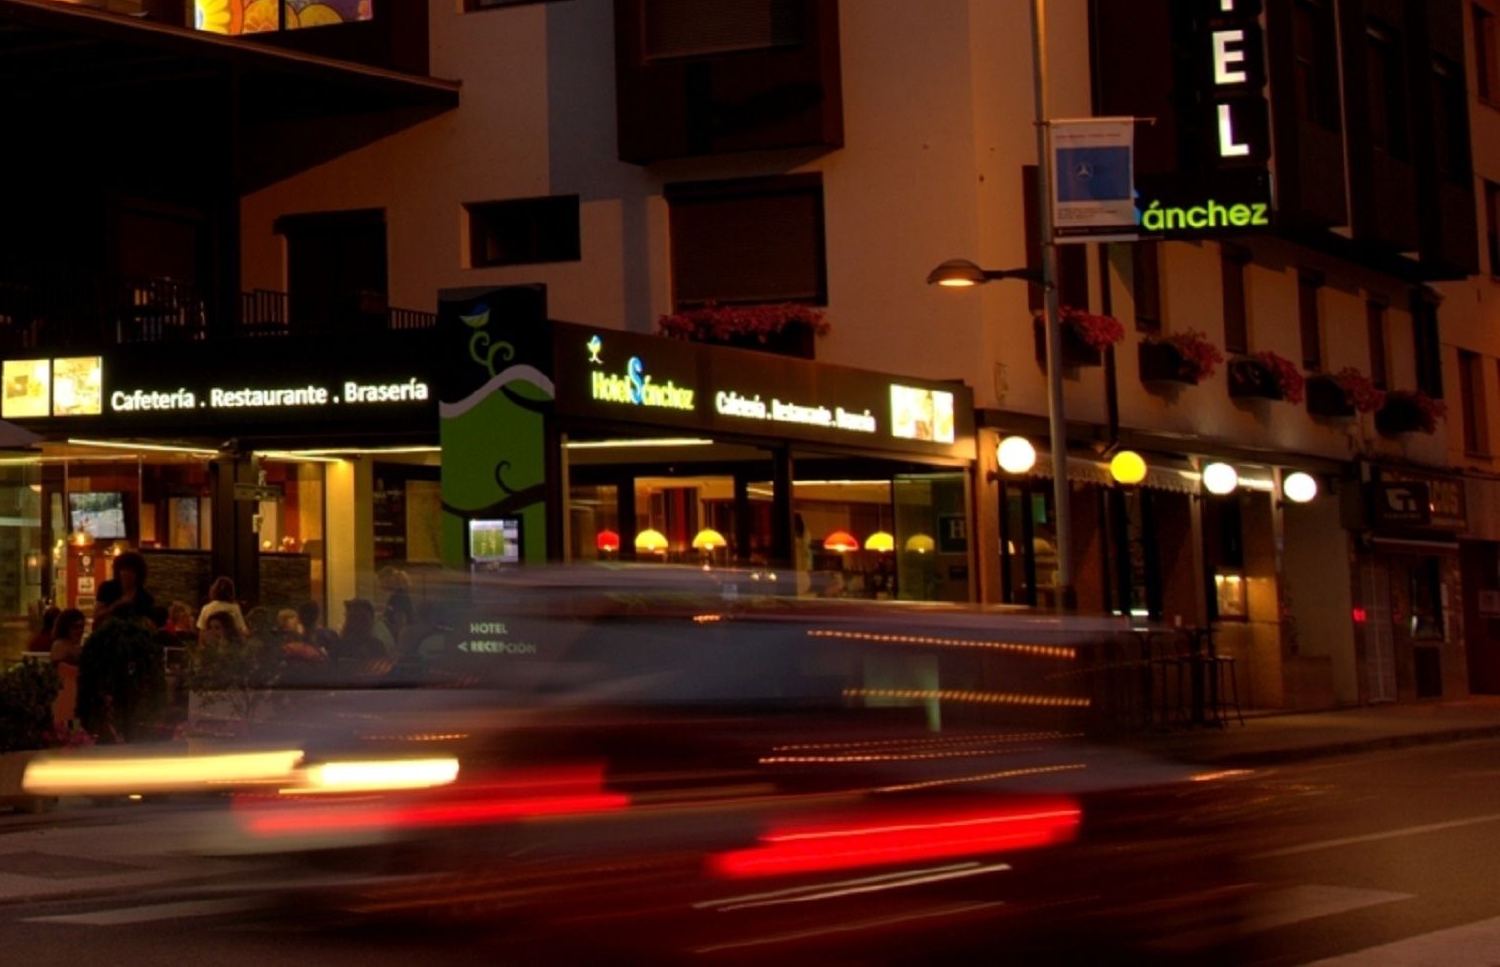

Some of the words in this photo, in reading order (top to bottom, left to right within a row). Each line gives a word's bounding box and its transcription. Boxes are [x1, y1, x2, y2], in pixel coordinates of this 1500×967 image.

[1134, 188, 1268, 231] ánchez
[111, 388, 195, 410] Cafetería
[211, 385, 328, 407] Restaurante
[344, 377, 428, 403] Brasería
[470, 623, 508, 634] HOTEL
